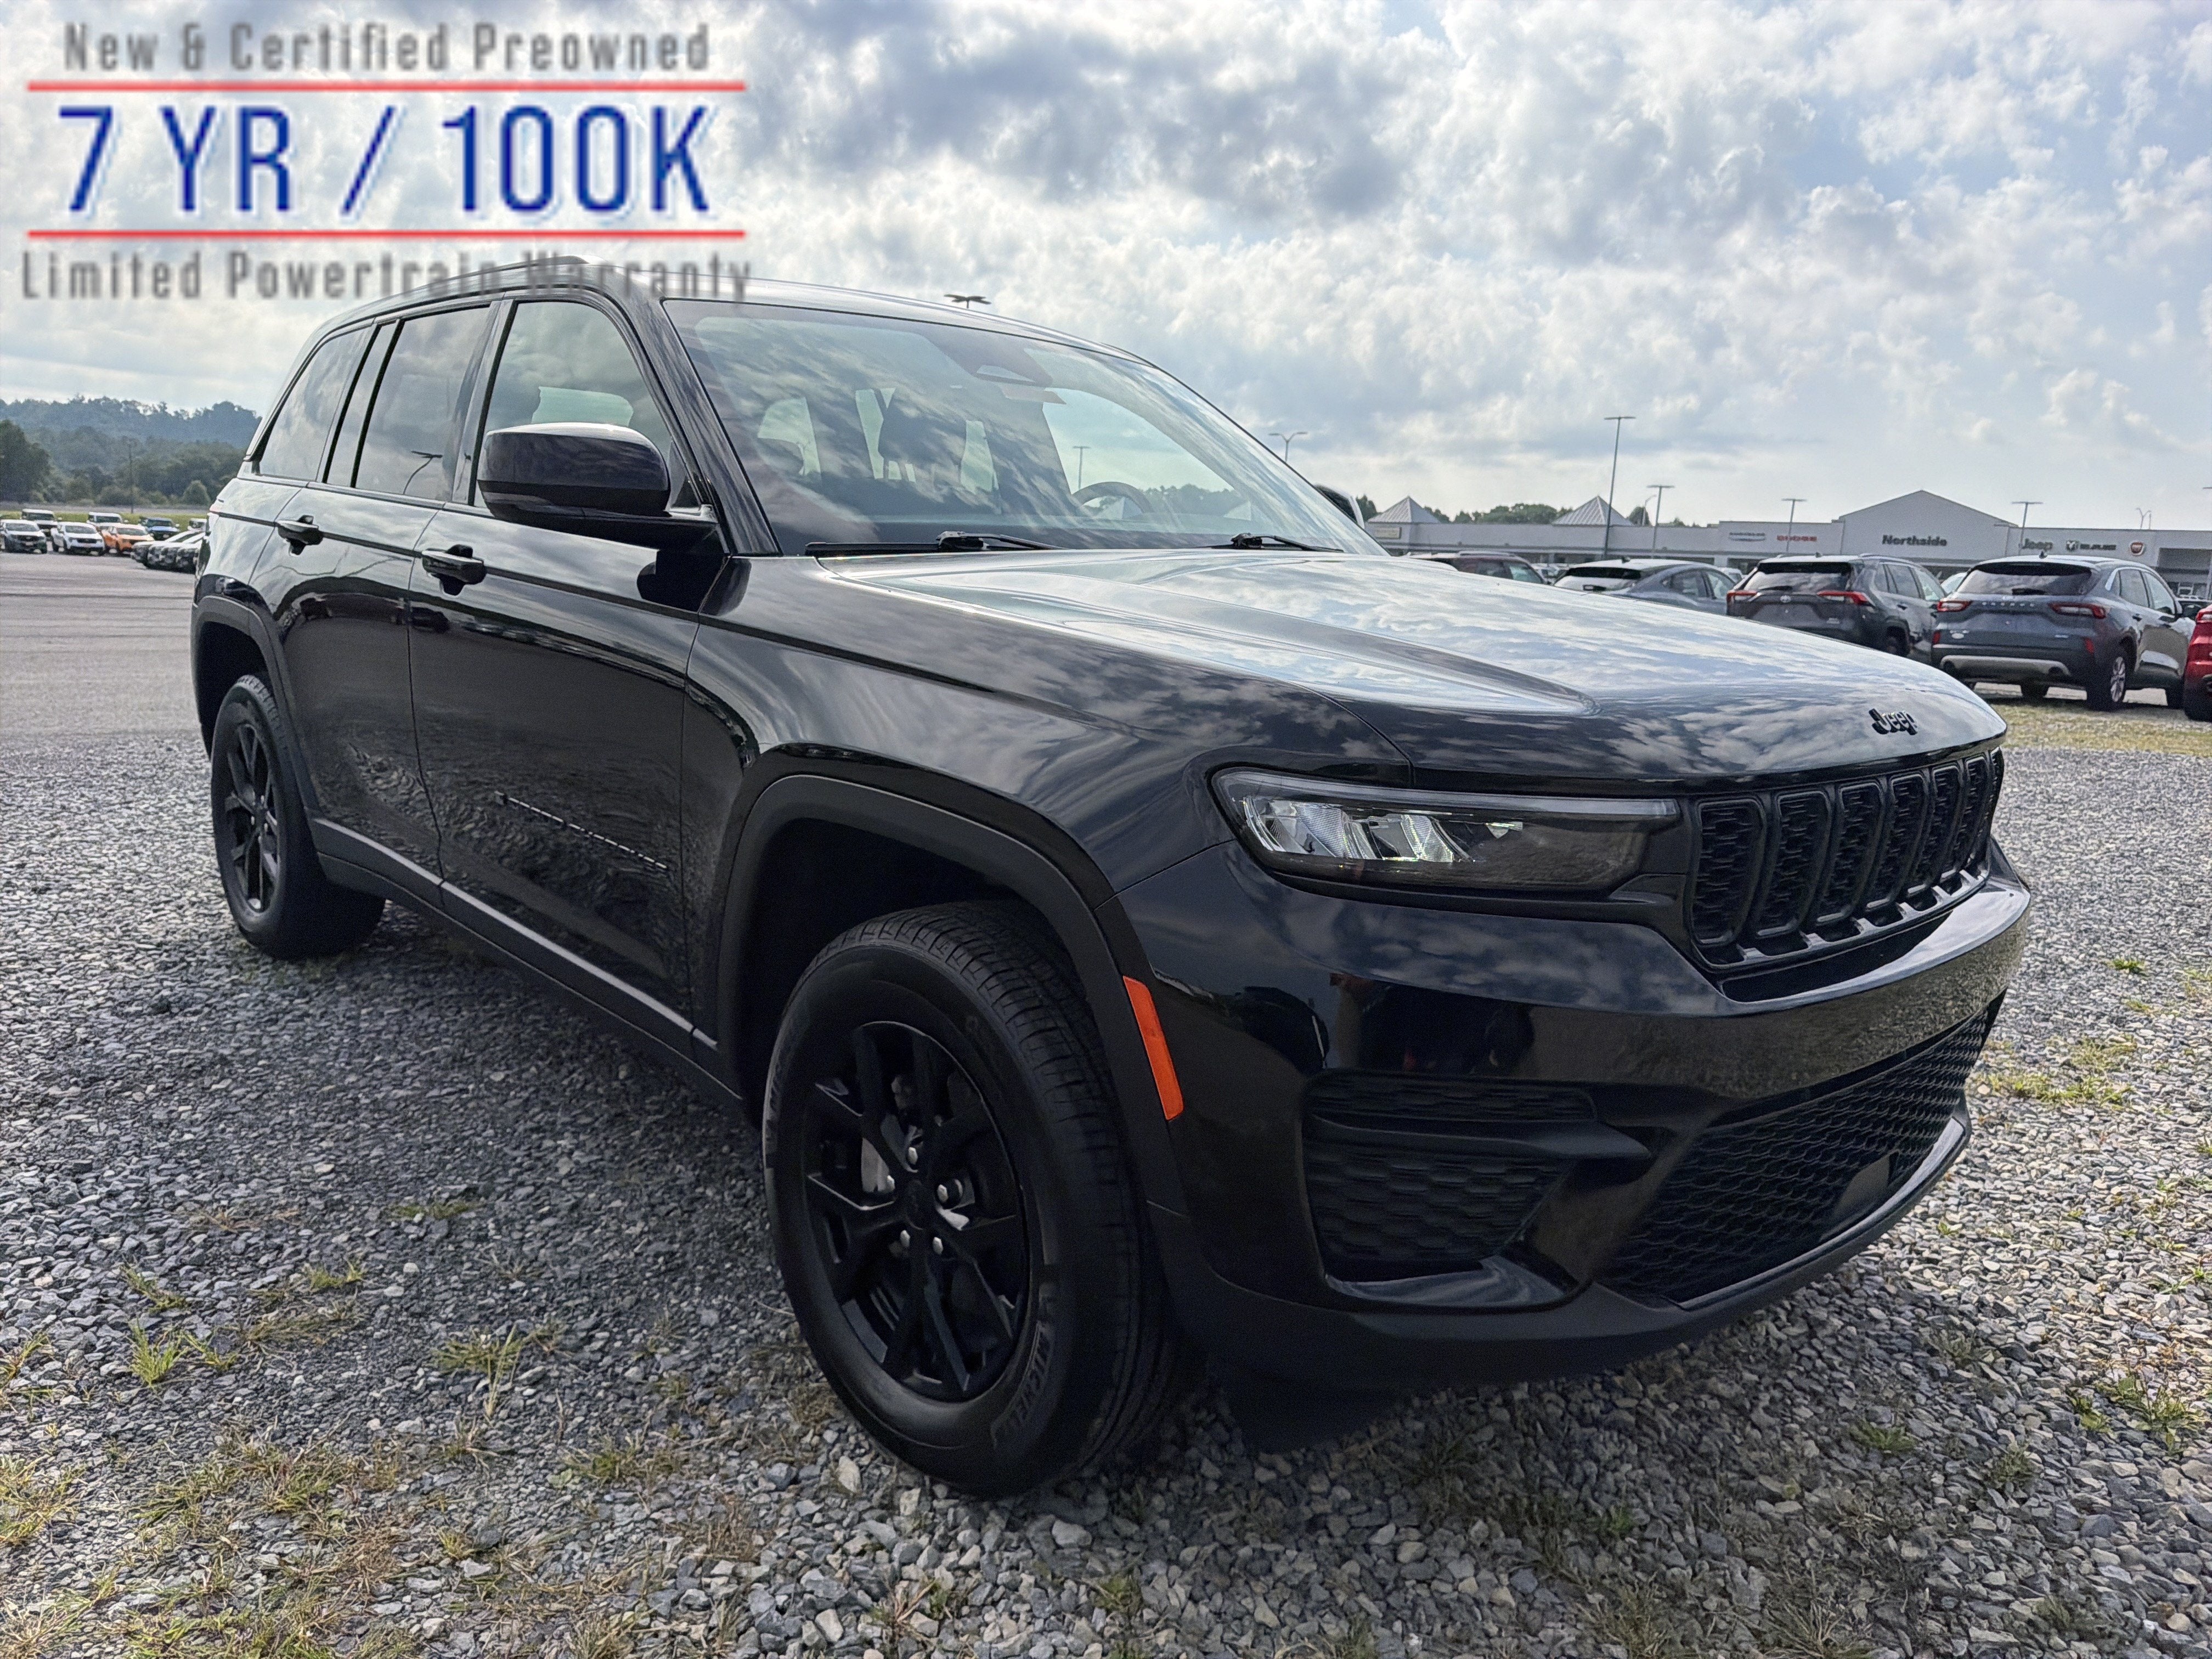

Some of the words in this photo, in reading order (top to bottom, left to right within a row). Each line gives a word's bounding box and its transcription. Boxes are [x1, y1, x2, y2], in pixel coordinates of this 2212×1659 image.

[1882, 534, 1948, 546] Northside
[2022, 538, 2053, 551] Jeep
[1868, 708, 1918, 735] Jeep
[997, 1332, 1051, 1435] MICHEL
